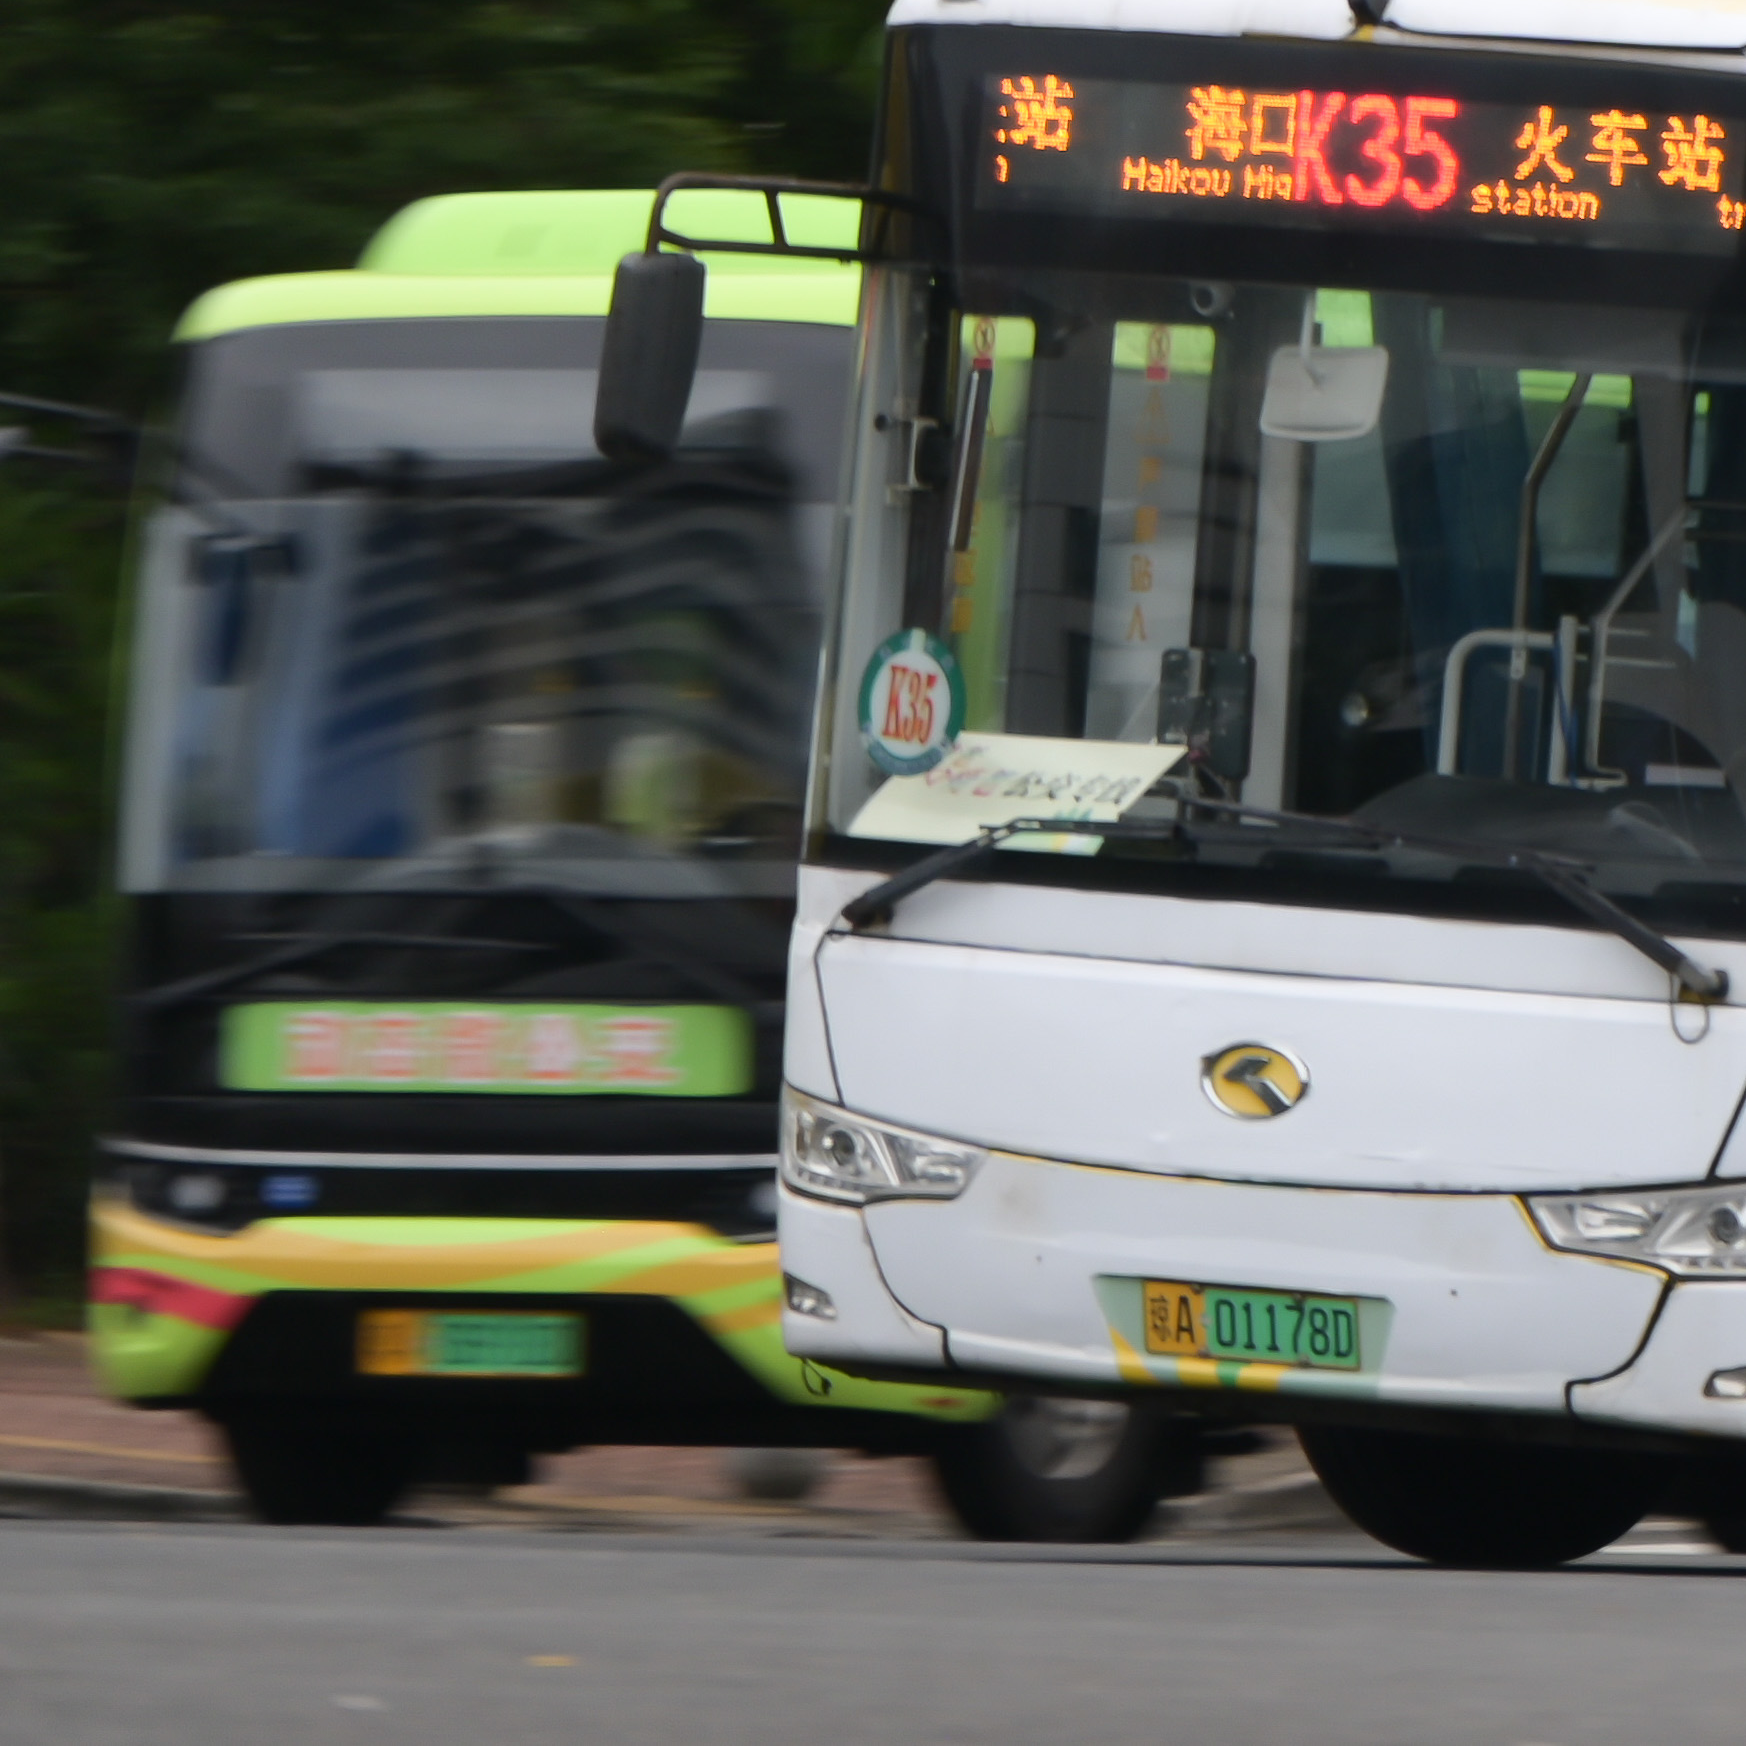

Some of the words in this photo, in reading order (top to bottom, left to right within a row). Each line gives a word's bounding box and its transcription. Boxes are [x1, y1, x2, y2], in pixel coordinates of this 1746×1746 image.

[996, 73, 1076, 153] 站
[1185, 84, 1297, 162] 海口
[1294, 88, 1461, 211] K35
[1514, 103, 1726, 193] 火车站
[1121, 155, 1231, 198] Haikou
[1470, 178, 1601, 221] station
[882, 664, 939, 746] K35
